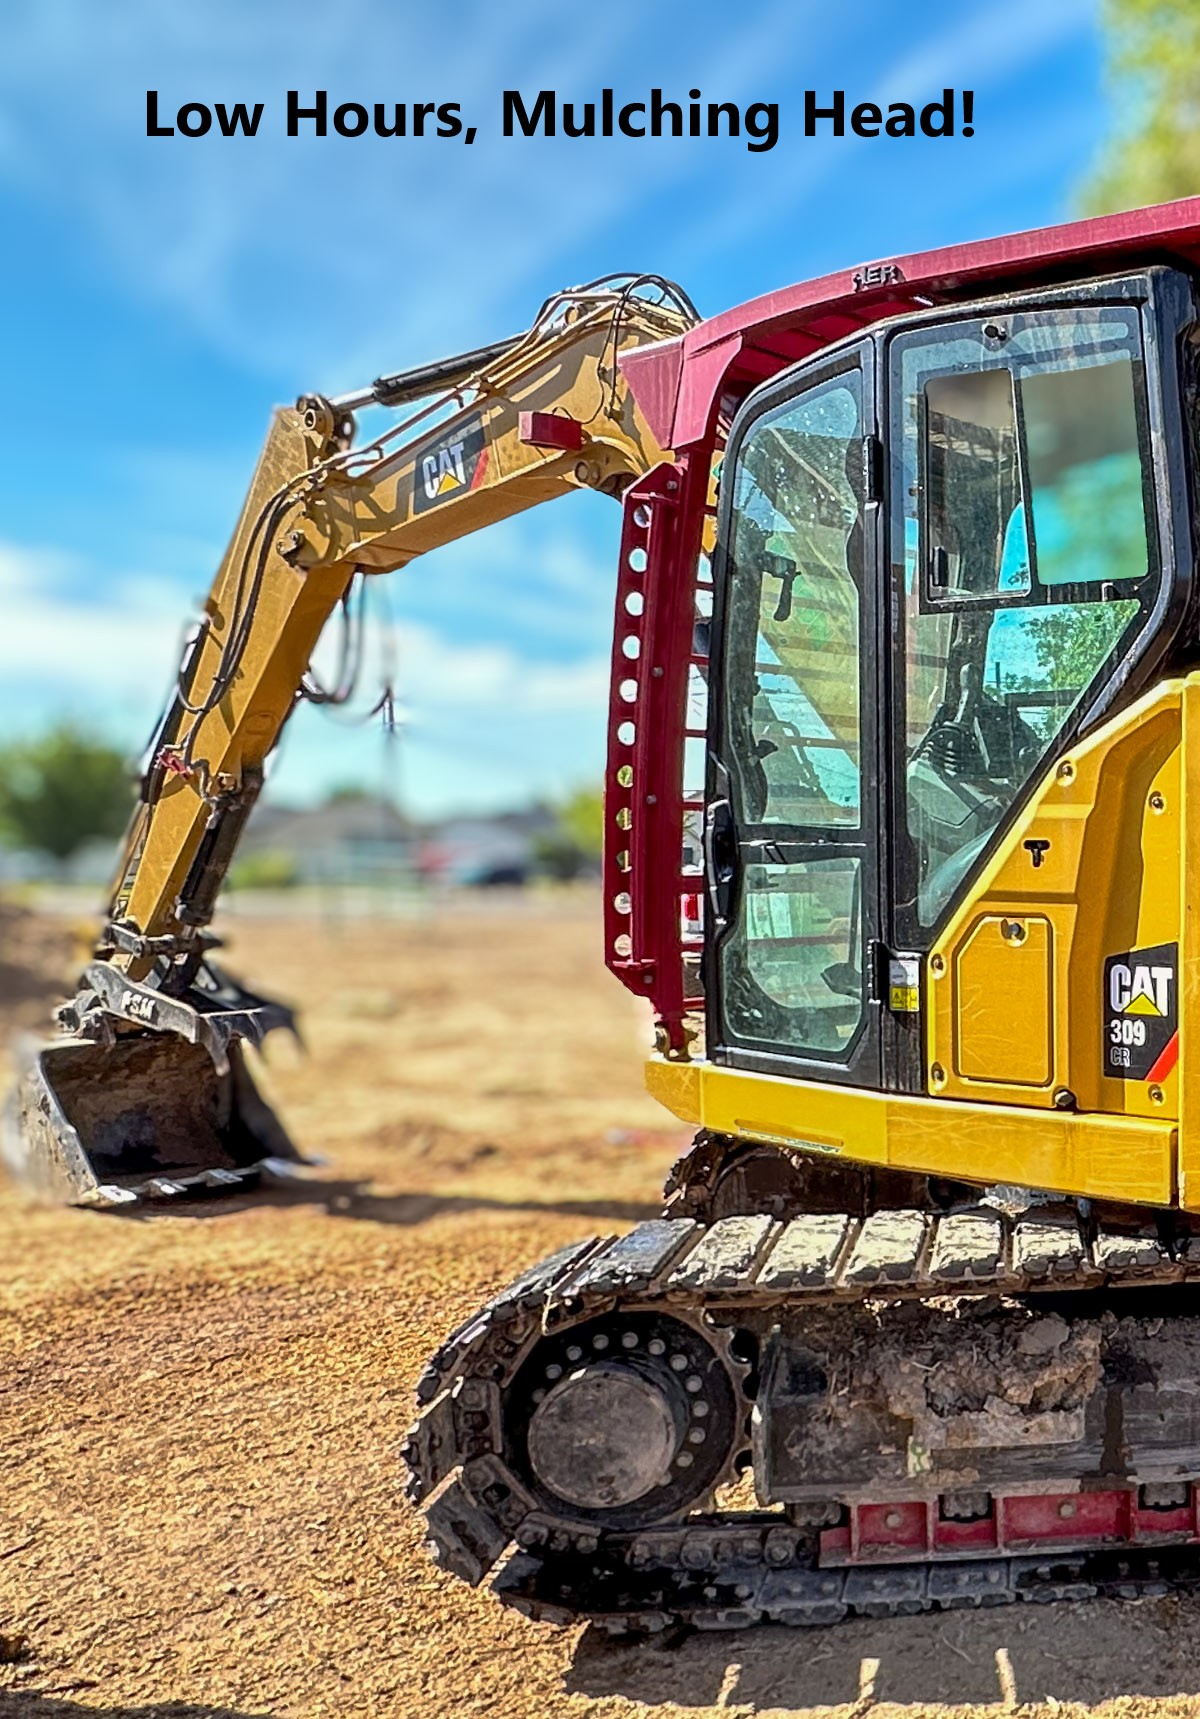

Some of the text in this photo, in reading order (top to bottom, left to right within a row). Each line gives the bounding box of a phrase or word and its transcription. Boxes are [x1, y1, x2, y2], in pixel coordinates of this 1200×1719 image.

[422, 441, 467, 499] CAT
[1110, 964, 1173, 1017] CAT
[1110, 1019, 1146, 1046] 309
[1110, 1046, 1131, 1068] CR
